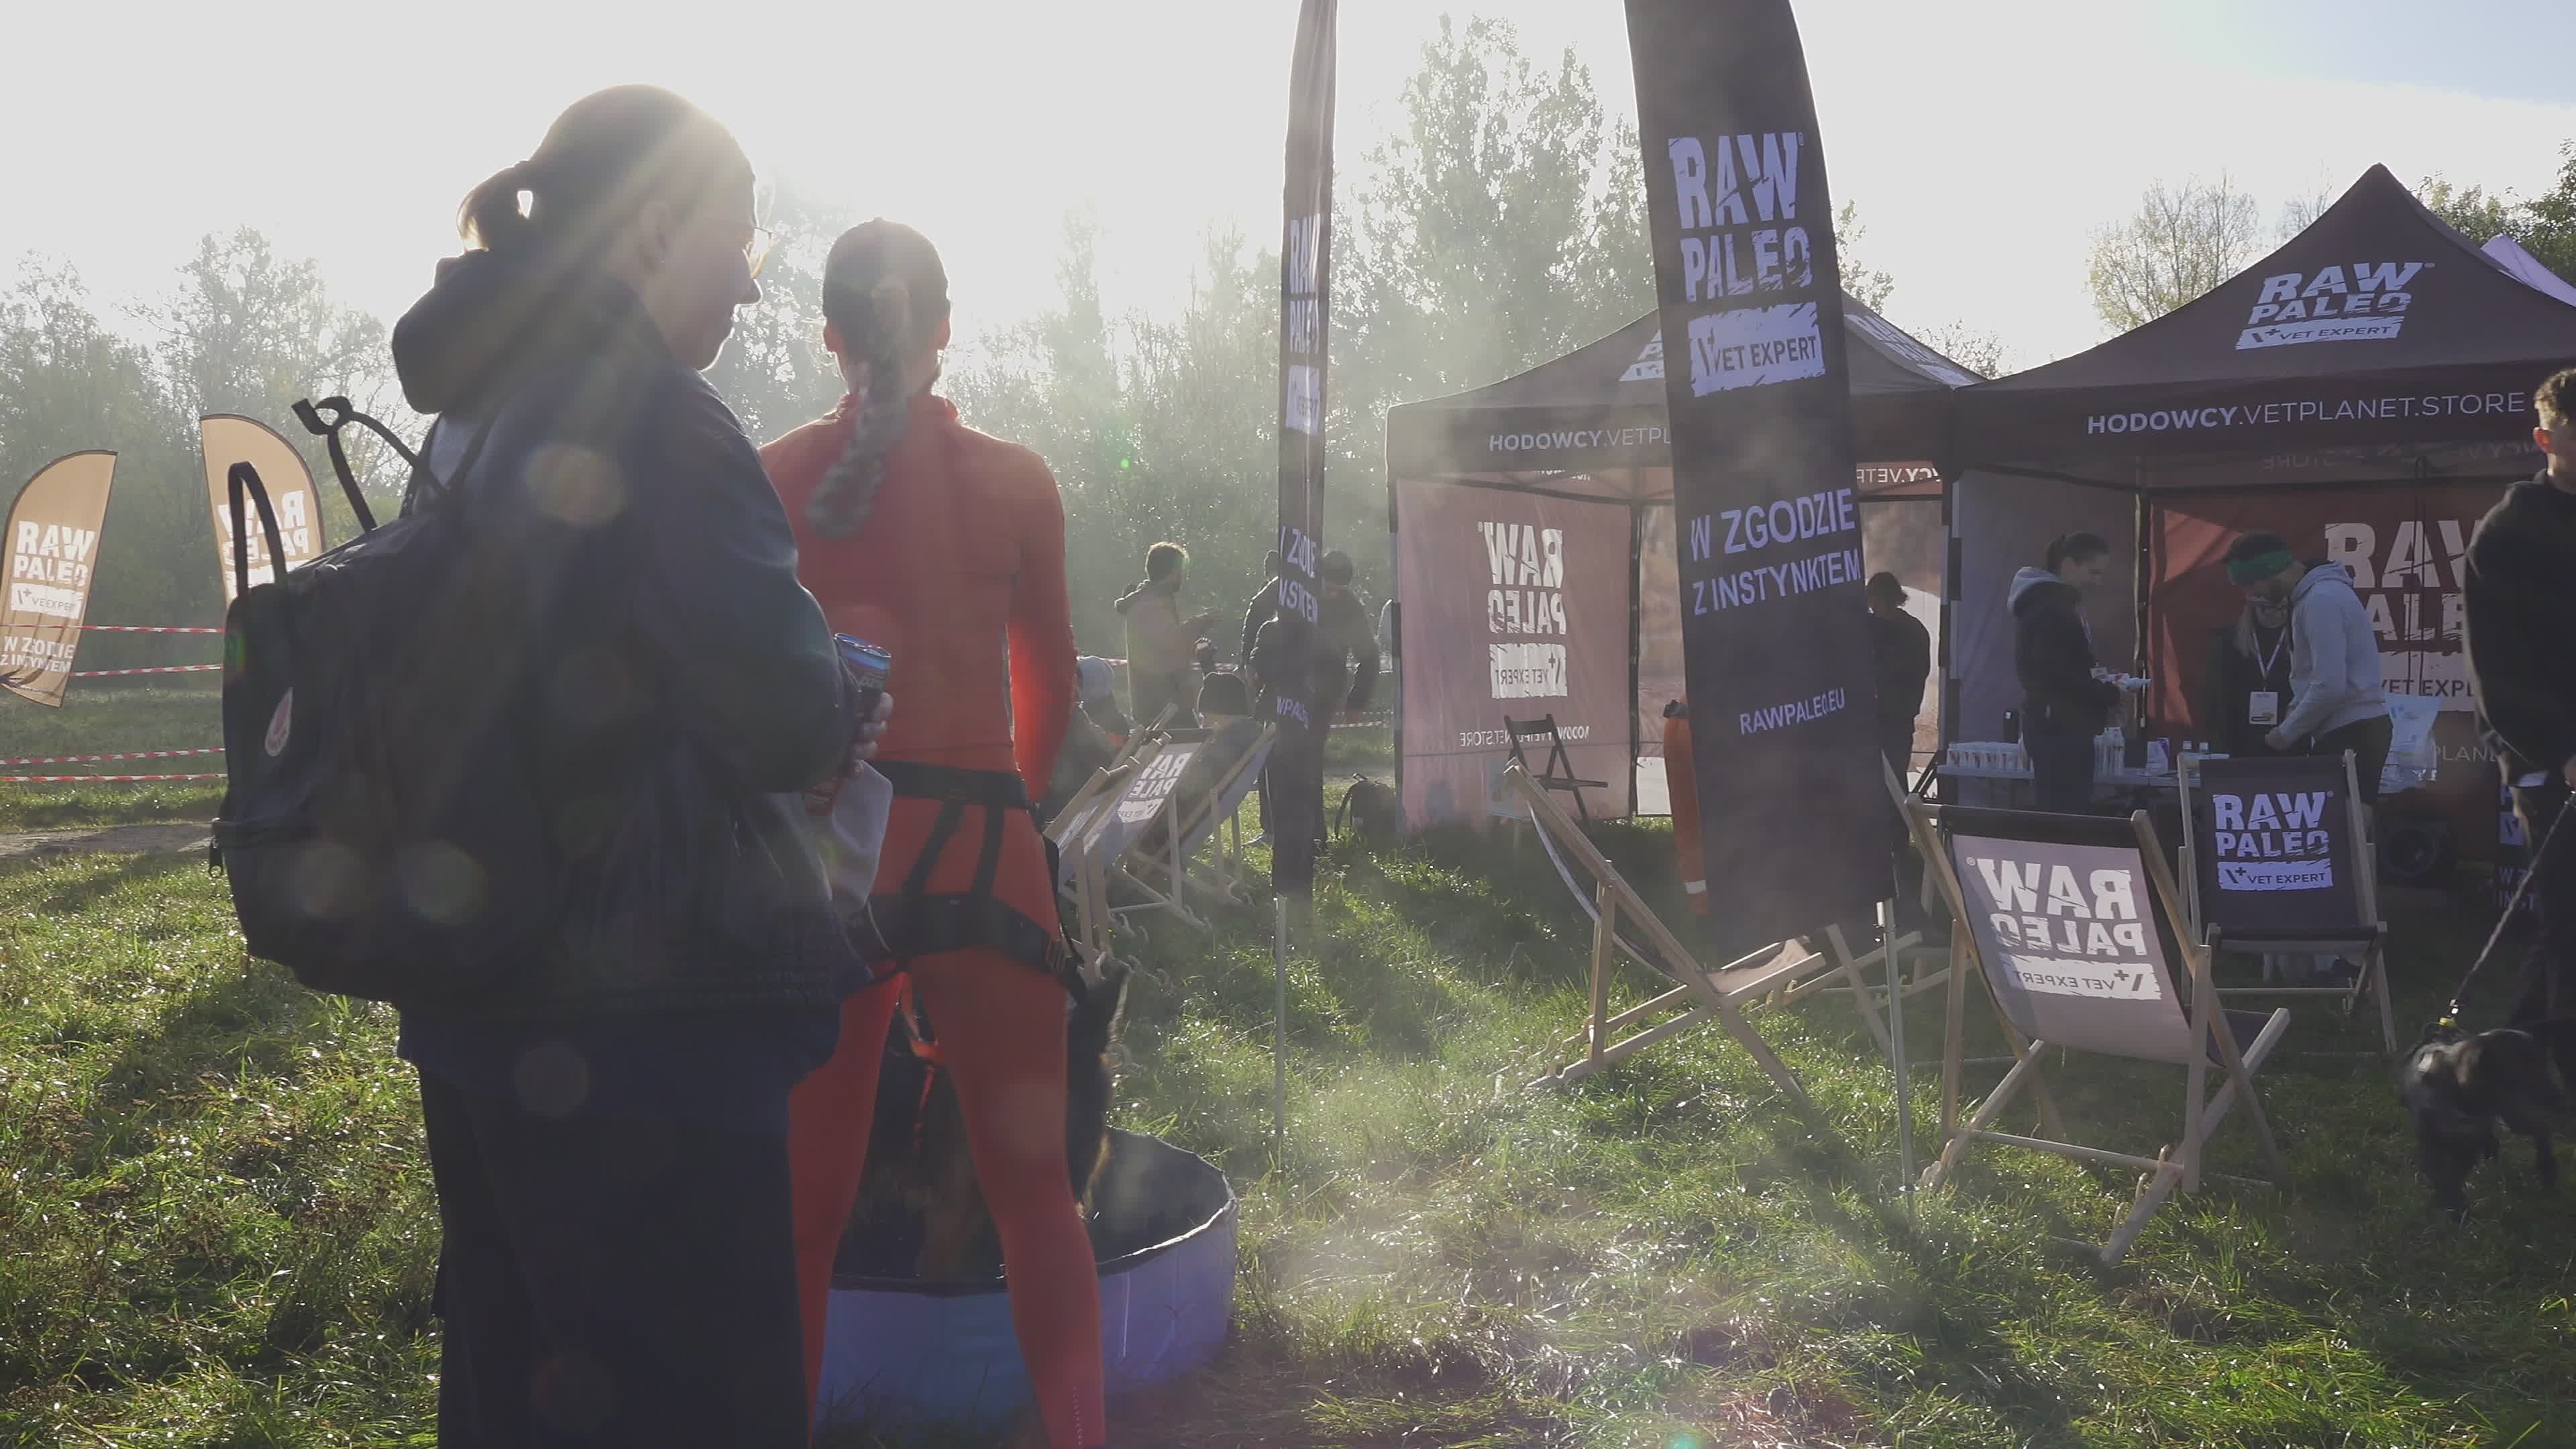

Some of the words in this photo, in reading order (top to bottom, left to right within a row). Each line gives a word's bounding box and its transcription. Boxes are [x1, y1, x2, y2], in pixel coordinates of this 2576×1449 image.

[1668, 132, 1799, 229] RAW
[1680, 227, 1813, 303] PALEO
[2257, 262, 2423, 305] RAW
[2248, 292, 2412, 325] PALEO
[1750, 335, 1817, 368] EXPERT
[2280, 330, 2314, 340] VET
[2318, 326, 2392, 336] EXPERT
[2087, 392, 2526, 435] HODOWCY.VETPLANET.STORE
[1489, 427, 1671, 451] HODOWCY.VETPL
[17, 521, 96, 562] RAW
[1690, 515, 1711, 562] W
[1720, 488, 1857, 555] ZGODZIE
[13, 554, 89, 587] PALEO
[1692, 580, 1708, 616] Z
[1711, 548, 1862, 612] INSTYNKTEM
[2212, 792, 2326, 830] RAW
[2215, 830, 2330, 857] PALEO
[2247, 875, 2272, 884] VET
[2276, 872, 2326, 884] EXPERT
